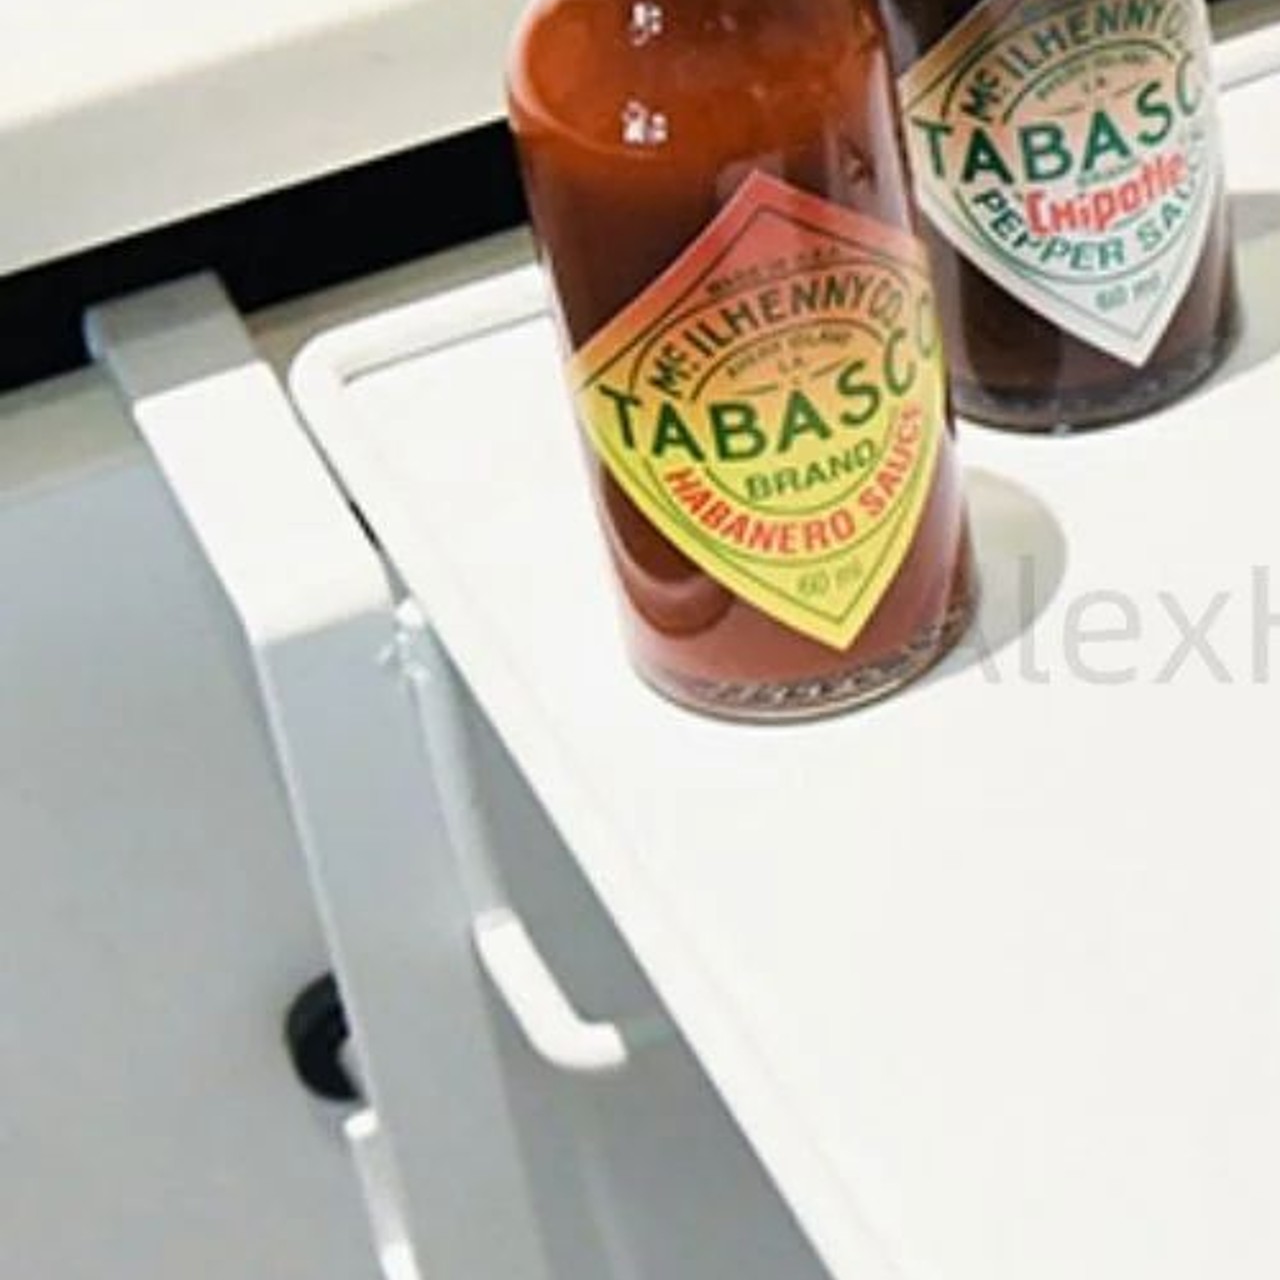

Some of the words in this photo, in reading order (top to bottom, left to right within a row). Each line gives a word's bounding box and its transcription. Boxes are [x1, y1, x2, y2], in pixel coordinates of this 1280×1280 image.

[911, 51, 1202, 185] TABASC
[973, 188, 1125, 270] PEPPER
[664, 464, 856, 554] HABANERO
[744, 436, 876, 502] BRAND
